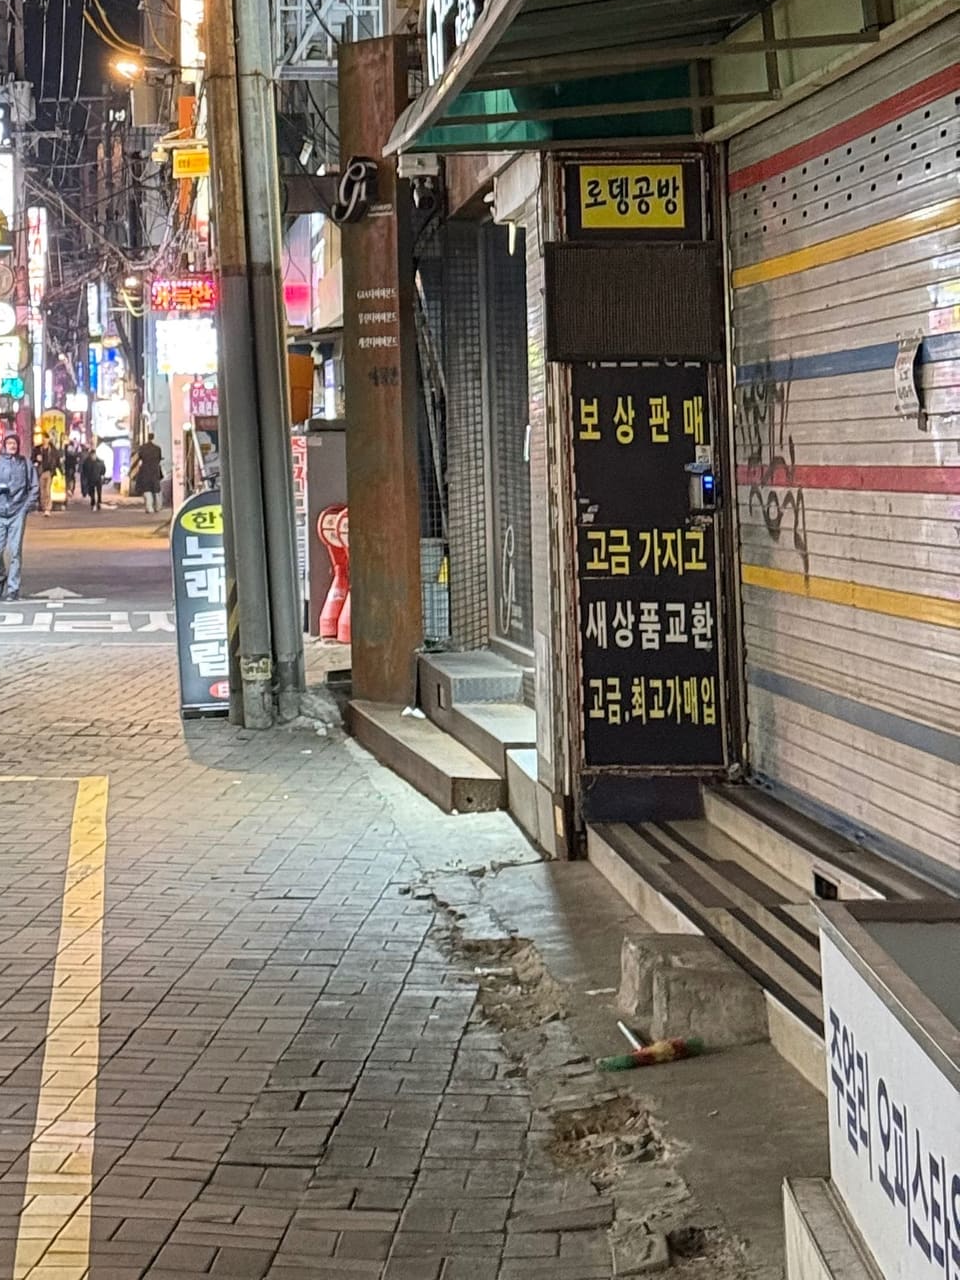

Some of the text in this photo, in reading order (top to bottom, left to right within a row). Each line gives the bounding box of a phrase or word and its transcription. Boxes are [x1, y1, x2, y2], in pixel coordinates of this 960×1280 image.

[584, 175, 680, 216] 로뎅공방
[579, 394, 704, 444] 보상판매
[585, 527, 708, 576] 고금 가지고
[585, 599, 714, 650] 새상품교환
[828, 1007, 874, 1182] 주얼리
